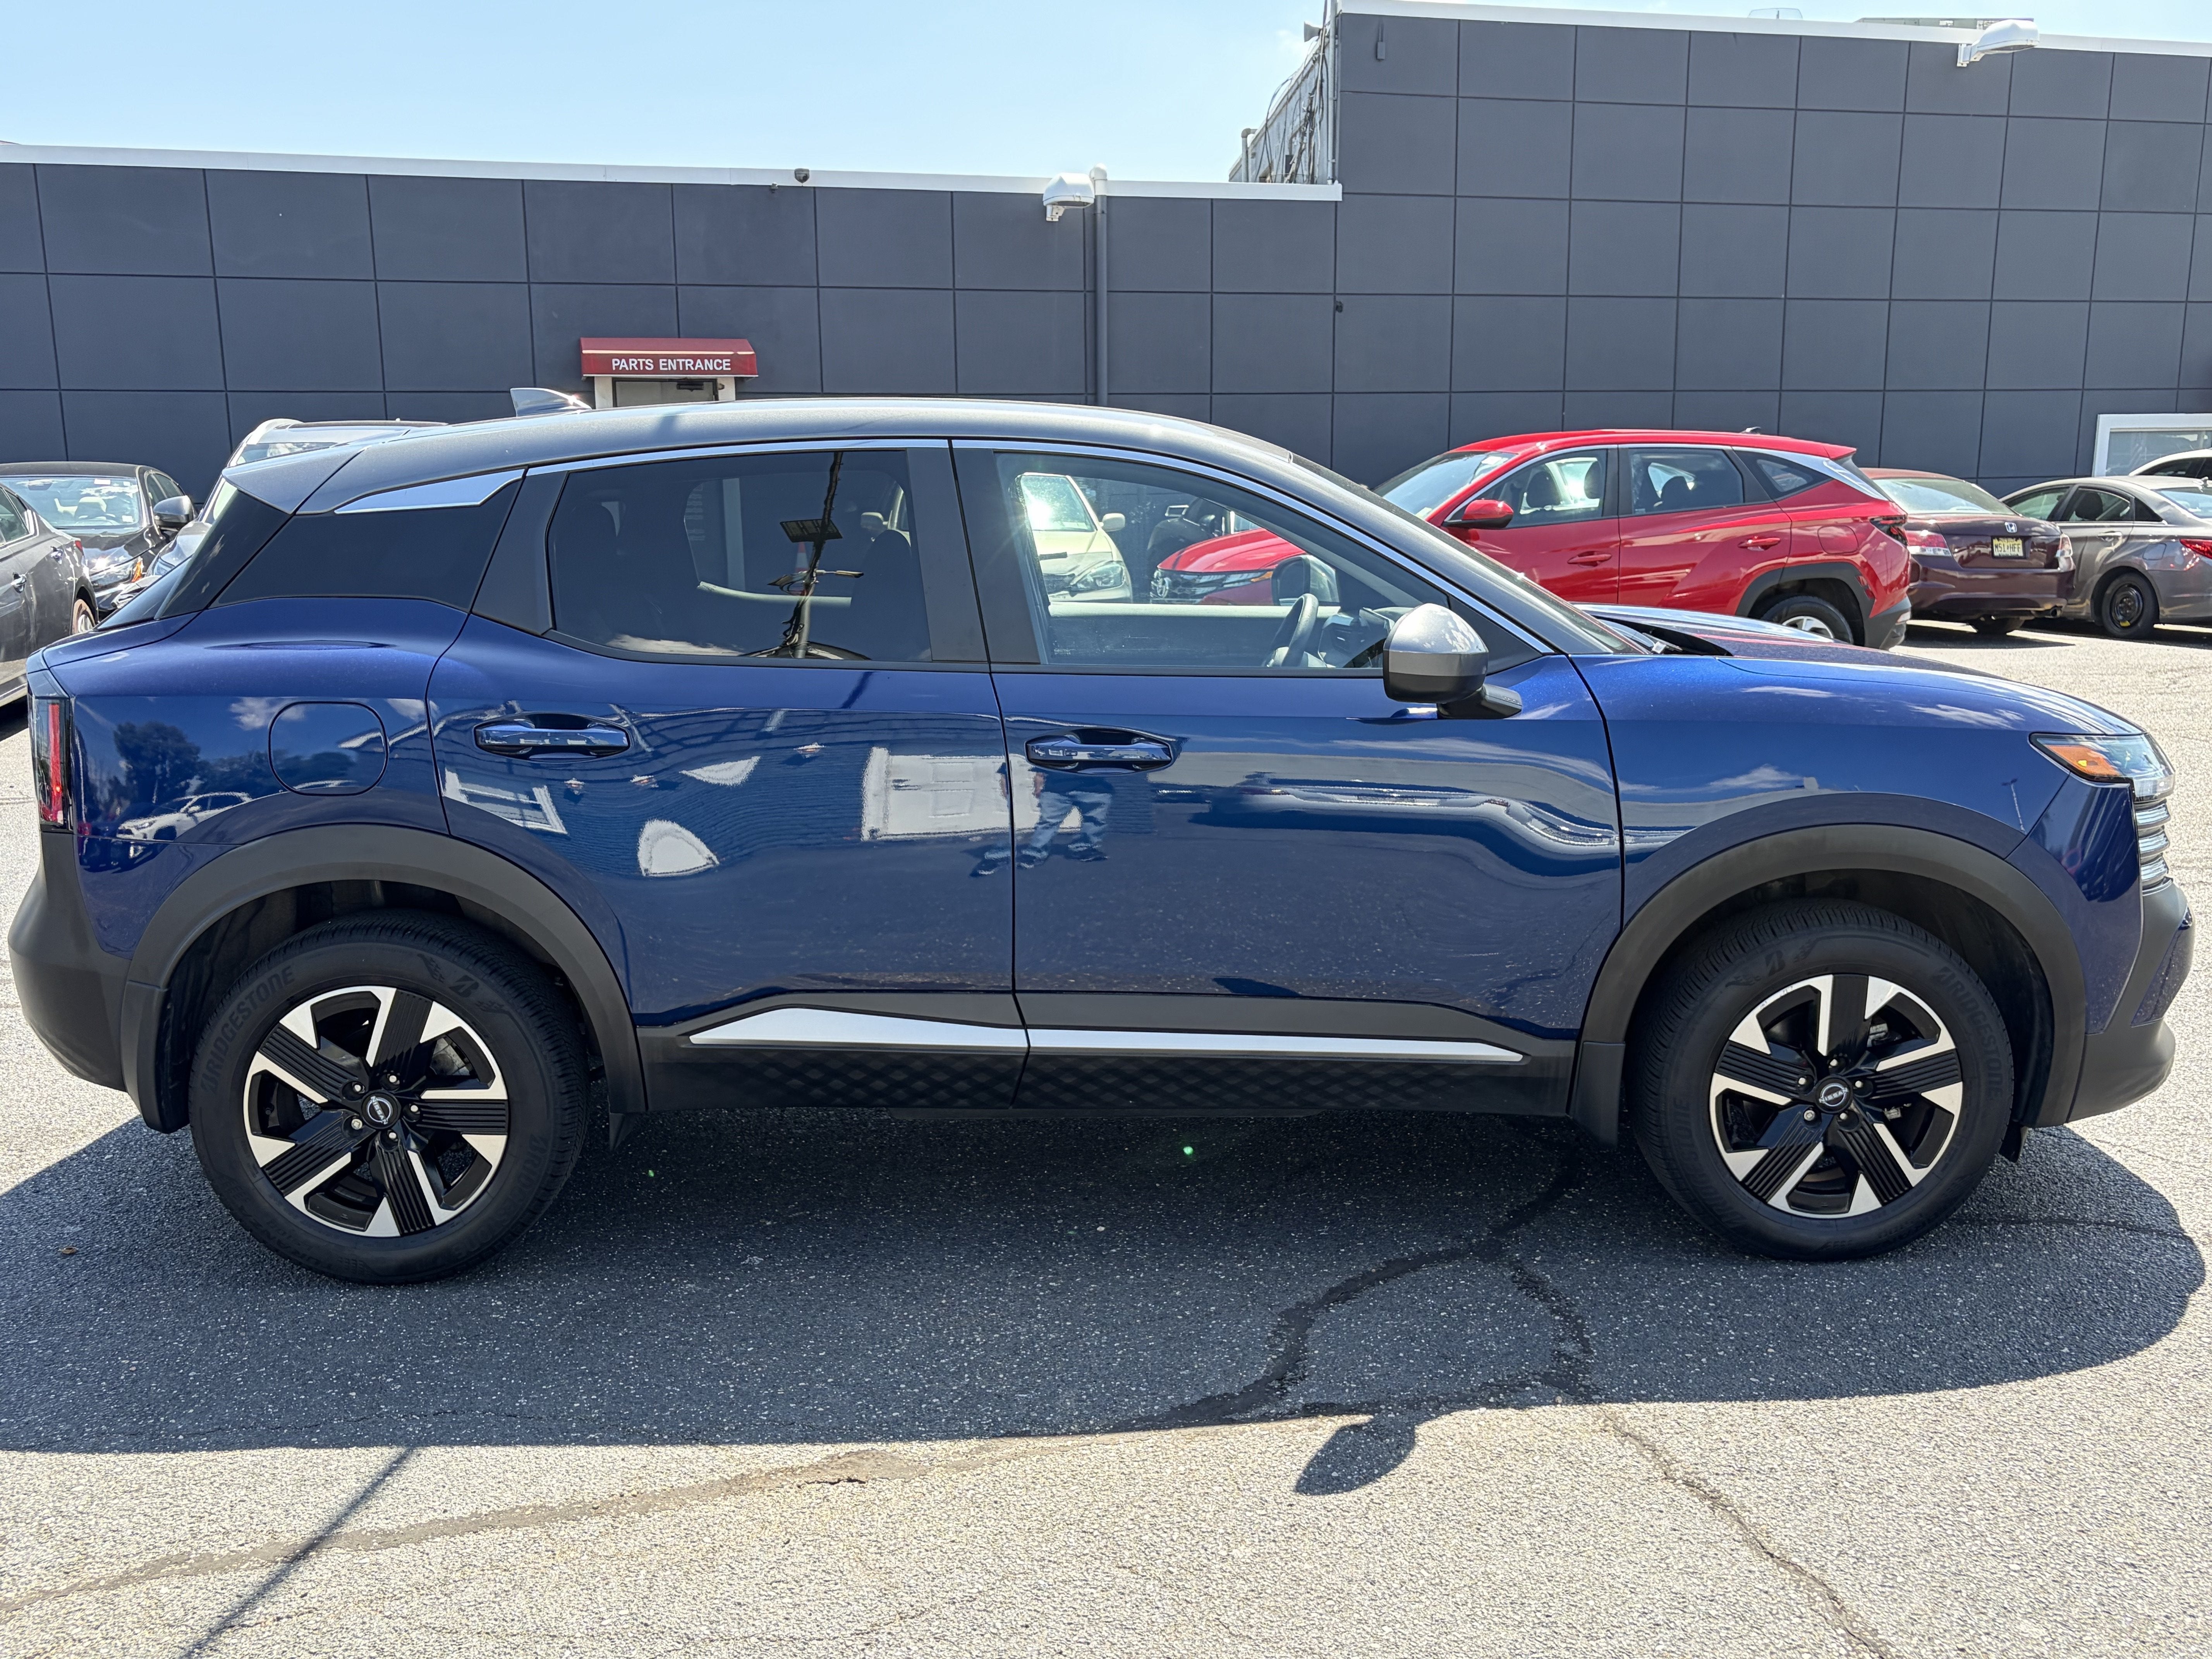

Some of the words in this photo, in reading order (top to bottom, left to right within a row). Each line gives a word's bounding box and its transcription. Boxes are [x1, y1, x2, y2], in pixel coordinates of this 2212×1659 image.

[612, 358, 654, 371] PARTS
[659, 359, 731, 371] ENTRANCE
[200, 965, 295, 1094] BRIDGESTONE
[1930, 966, 2003, 1101] BRIDGESTONE
[1819, 1087, 1849, 1104] NISSAN
[370, 1096, 388, 1125] NISSAN
